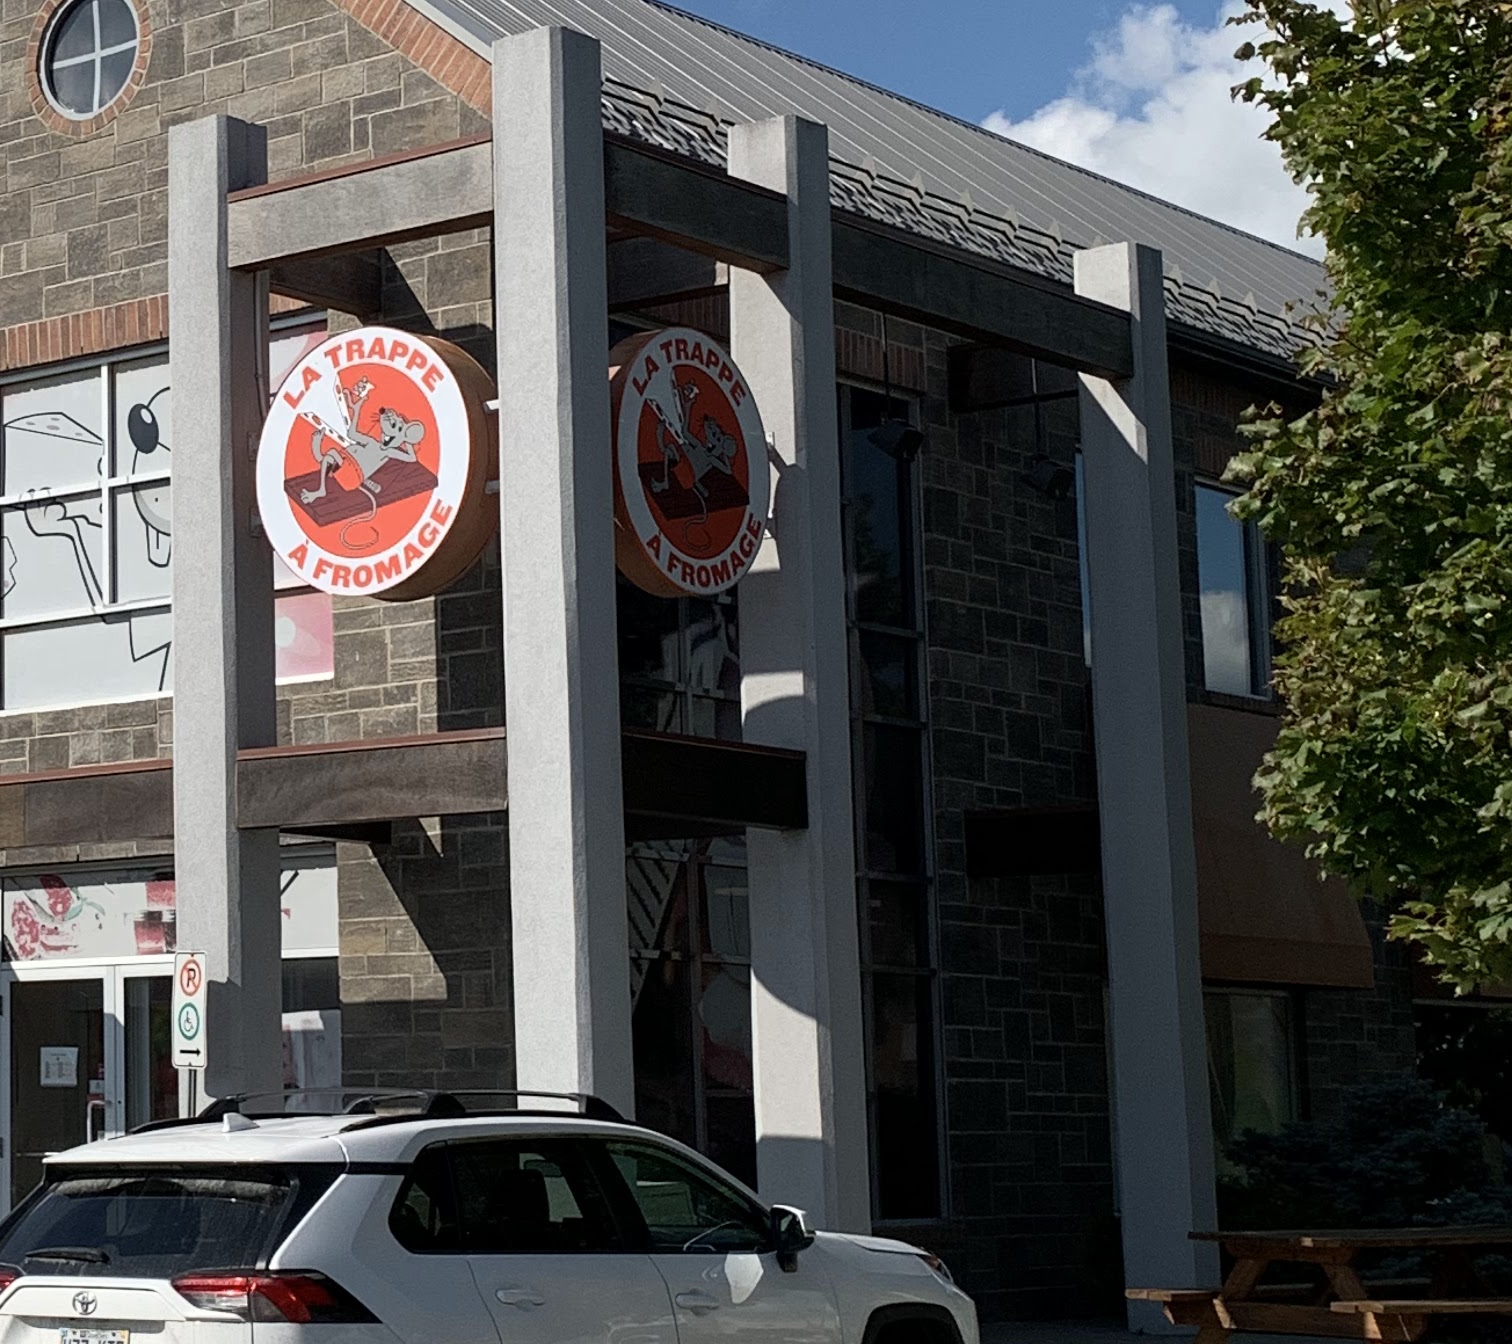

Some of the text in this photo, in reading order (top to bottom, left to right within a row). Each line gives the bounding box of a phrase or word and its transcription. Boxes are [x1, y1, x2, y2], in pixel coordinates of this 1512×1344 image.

[283, 337, 444, 409] LA TRAPPE
[632, 338, 746, 407] LA TRAPPE
[288, 499, 453, 588] À FROMAGE
[646, 512, 762, 588] À FROMAGE
